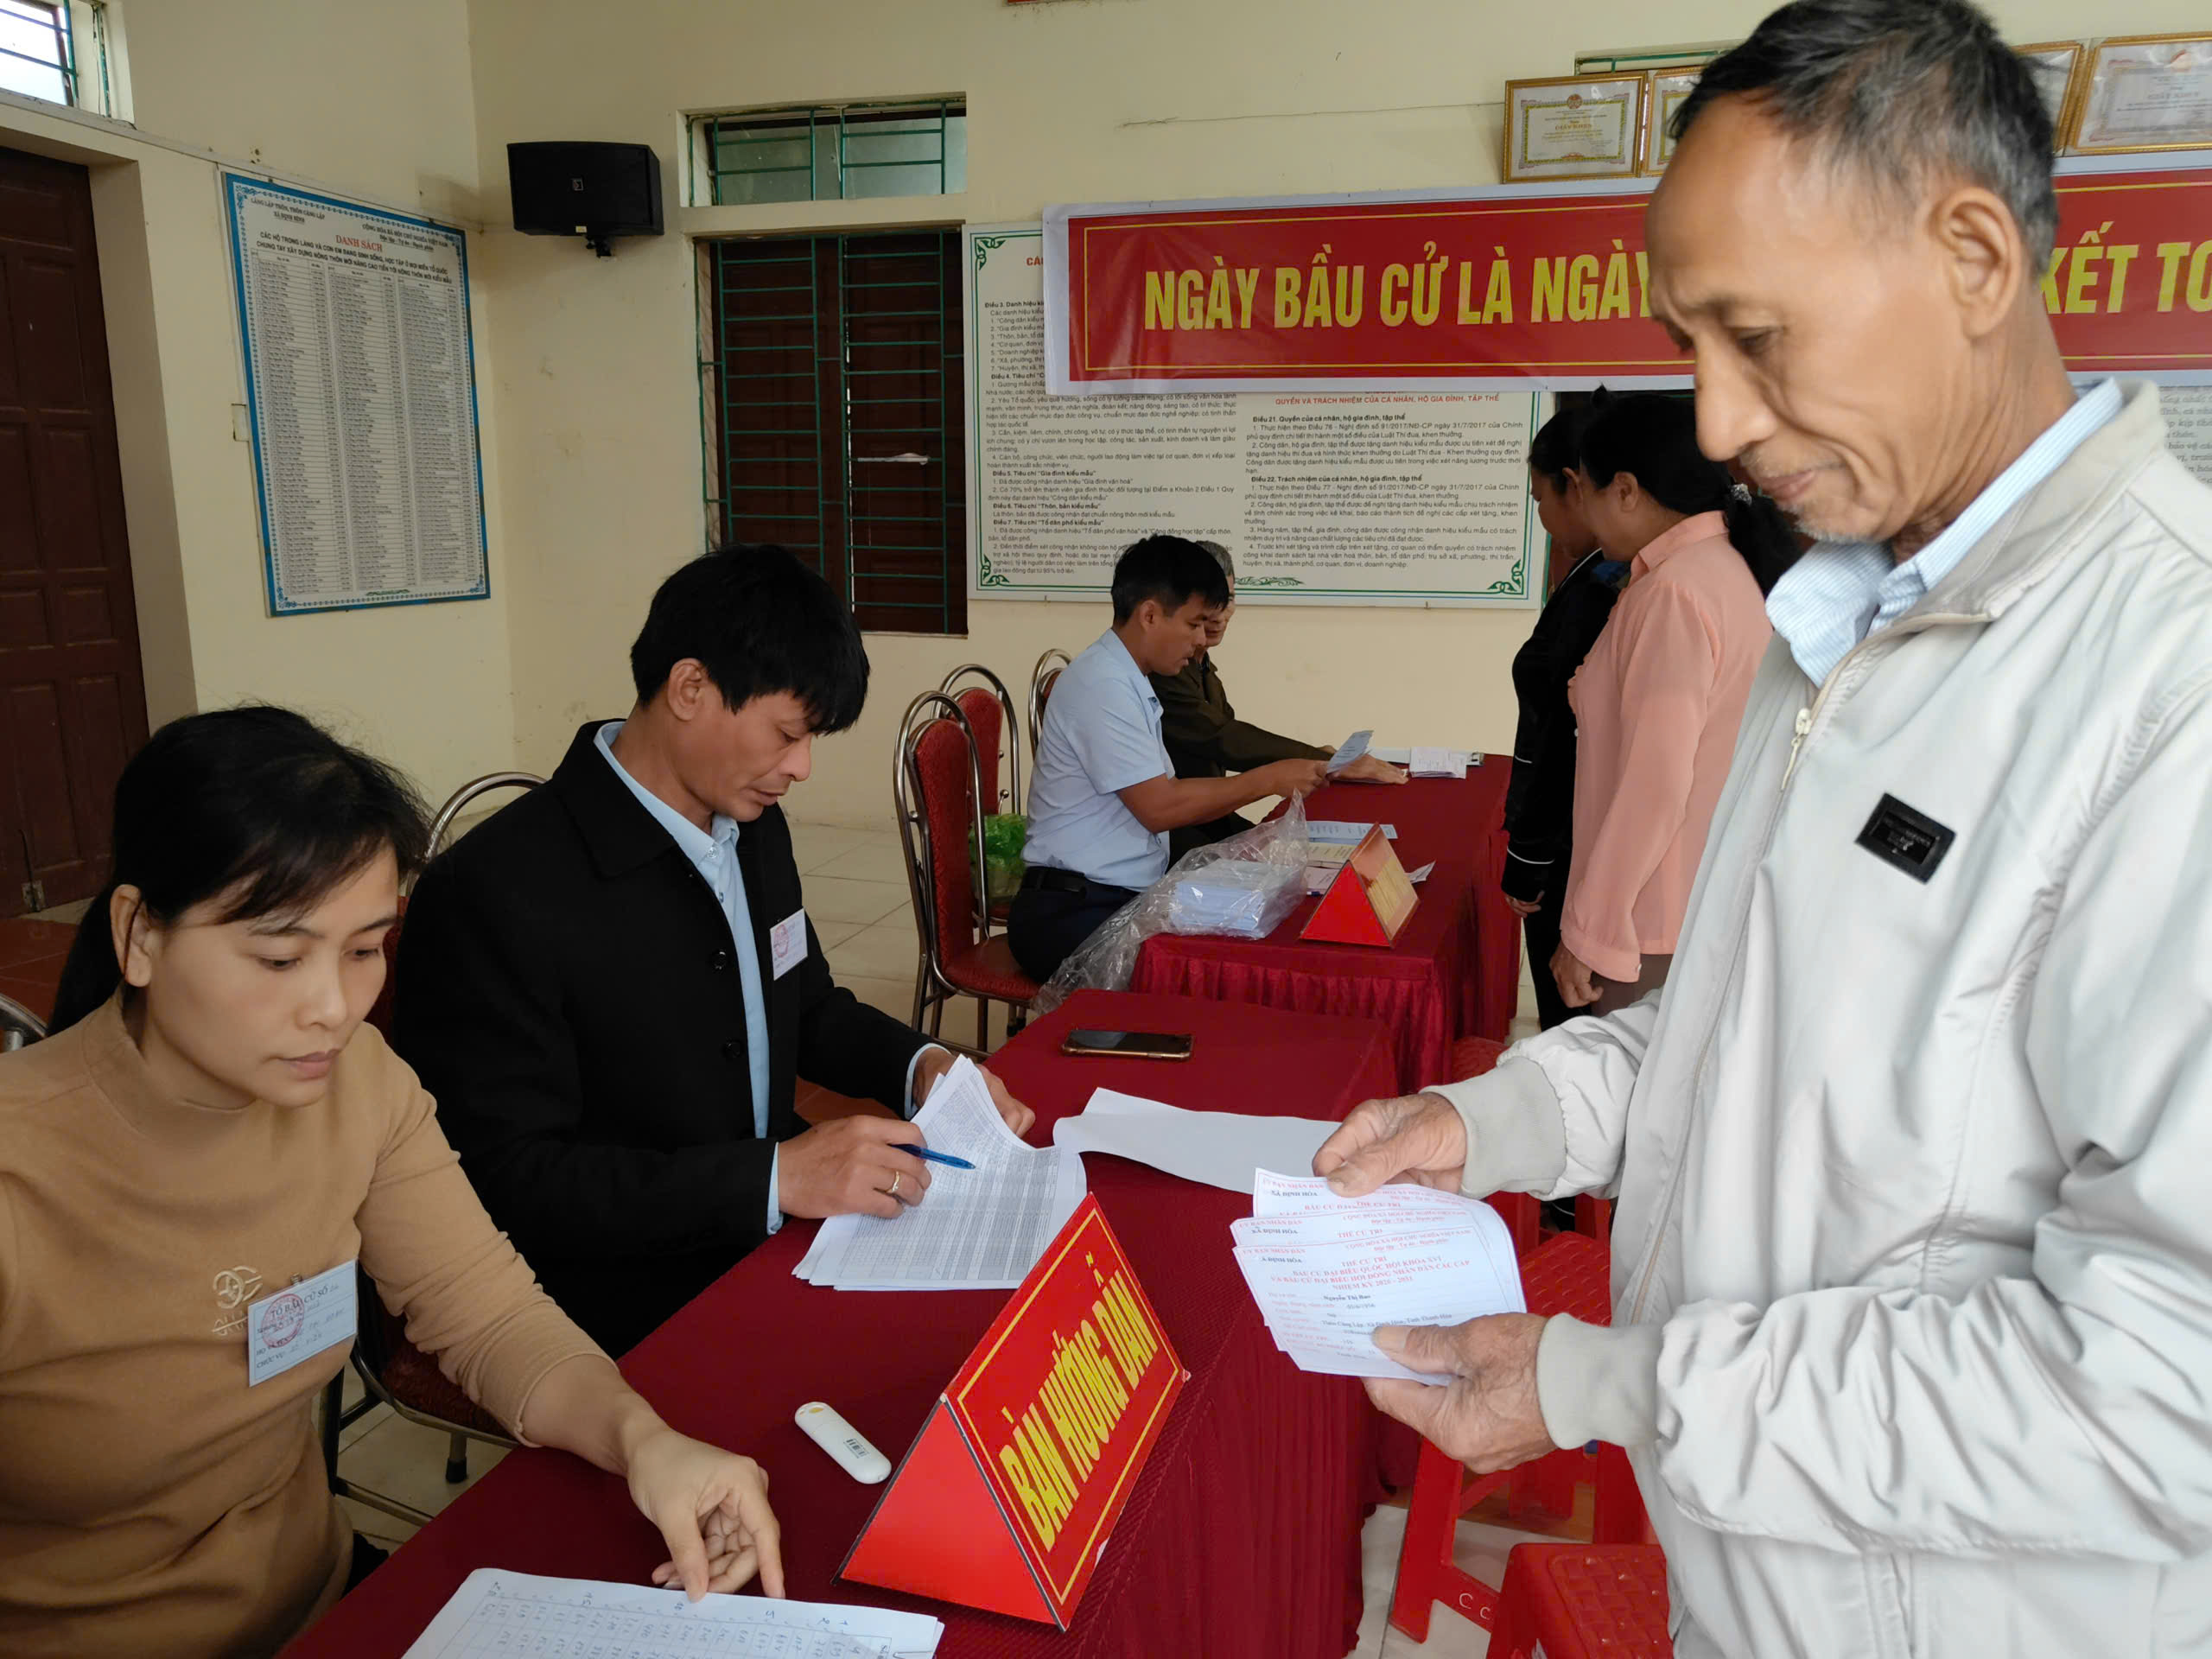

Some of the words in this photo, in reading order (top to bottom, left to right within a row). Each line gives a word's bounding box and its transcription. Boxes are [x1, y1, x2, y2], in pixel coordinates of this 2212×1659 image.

[336, 234, 360, 248] DANH
[361, 239, 382, 252] SÁCH
[1144, 256, 1260, 331] NGÀY
[1274, 243, 1365, 329] BẦU
[1381, 241, 1449, 328] CỬ
[1457, 246, 1514, 325] LÀ
[2040, 221, 2139, 314] KẾT
[1275, 396, 1300, 405] QUYỀN
[1417, 394, 1429, 402] HỘ
[1085, 1251, 1158, 1390] DẪN
[1038, 1319, 1130, 1484] HƯỚNG
[999, 1406, 1079, 1553] BÀN
